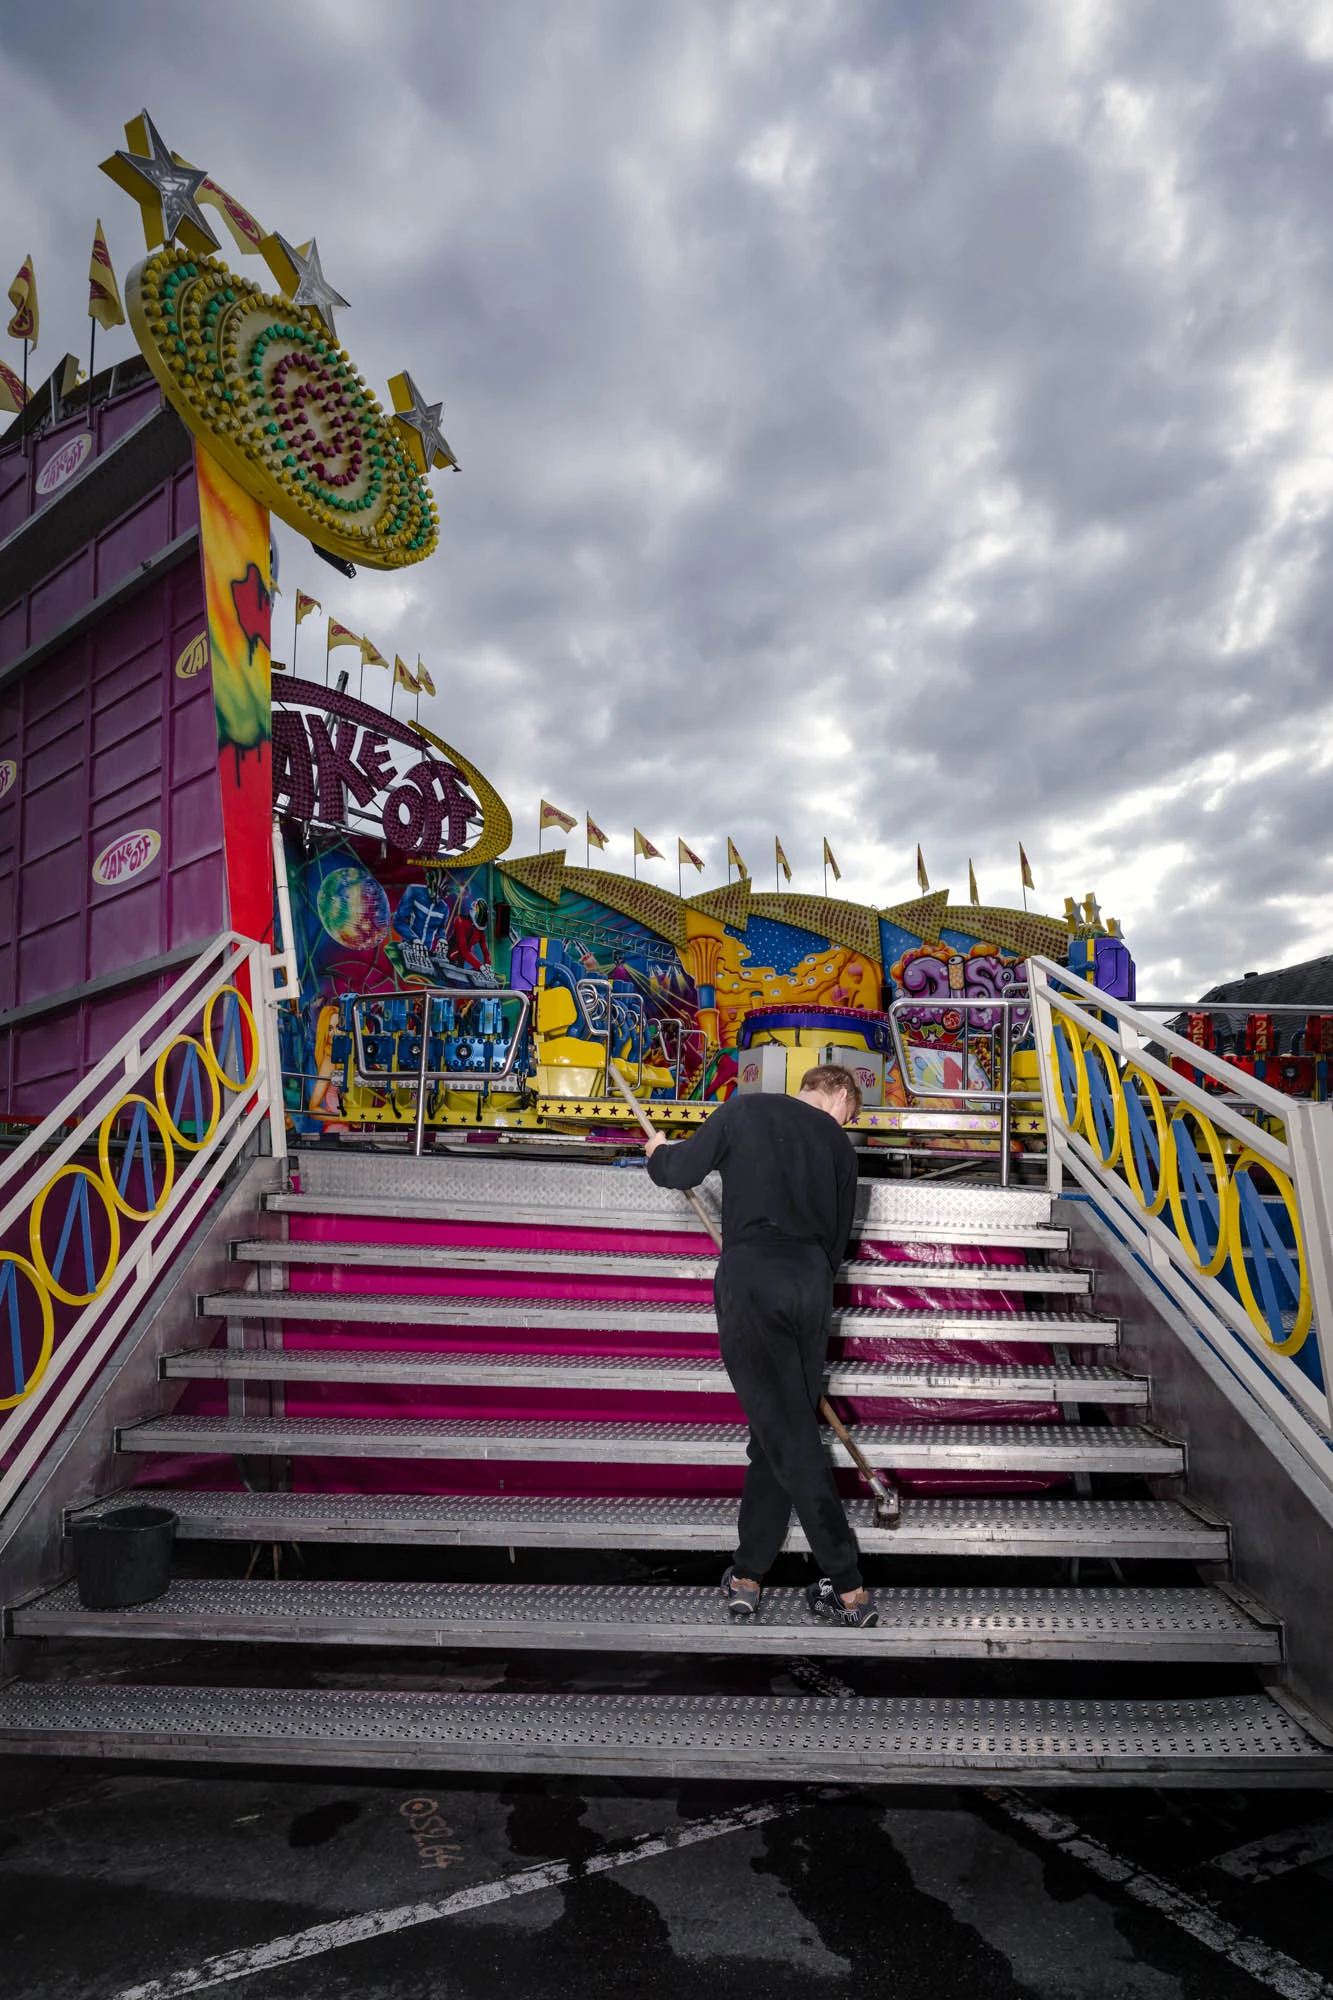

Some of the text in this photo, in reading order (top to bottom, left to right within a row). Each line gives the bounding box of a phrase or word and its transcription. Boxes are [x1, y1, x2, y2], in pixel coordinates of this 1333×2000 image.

[382, 759, 477, 854] OFF
[99, 834, 151, 880] TAKE OFF
[383, 1009, 393, 1023] 9
[1255, 1020, 1268, 1049] 24
